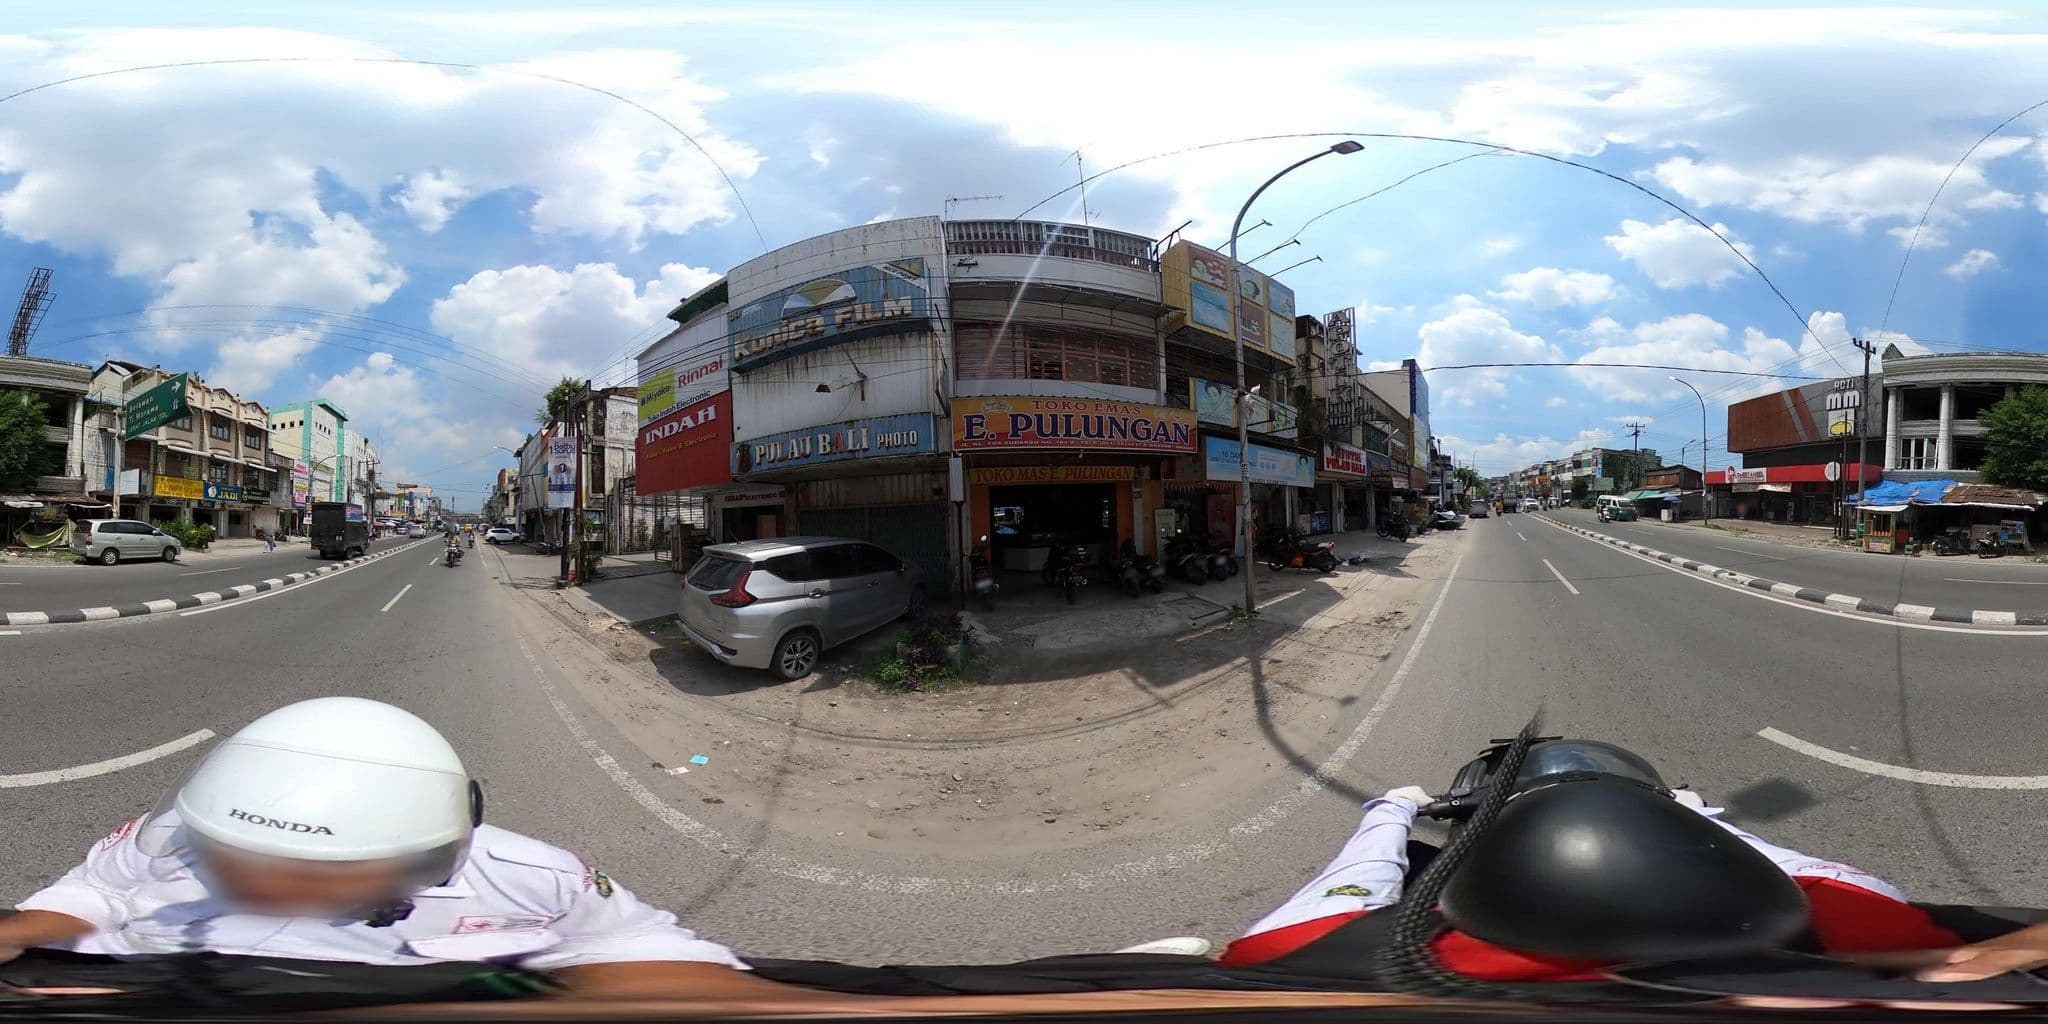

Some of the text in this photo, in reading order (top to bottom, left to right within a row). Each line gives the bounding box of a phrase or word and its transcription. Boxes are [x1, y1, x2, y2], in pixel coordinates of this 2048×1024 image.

[678, 354, 723, 388] Rinnai
[1032, 400, 1142, 415] TOKO EMAS
[645, 404, 717, 445] INDAH
[963, 412, 1190, 445] E. PULUNGAN
[755, 427, 918, 466] PULAU BALI PHOTO
[976, 469, 1015, 482] TOKO
[1064, 466, 1132, 480] PULUNGAN
[229, 808, 336, 836] HONDA
